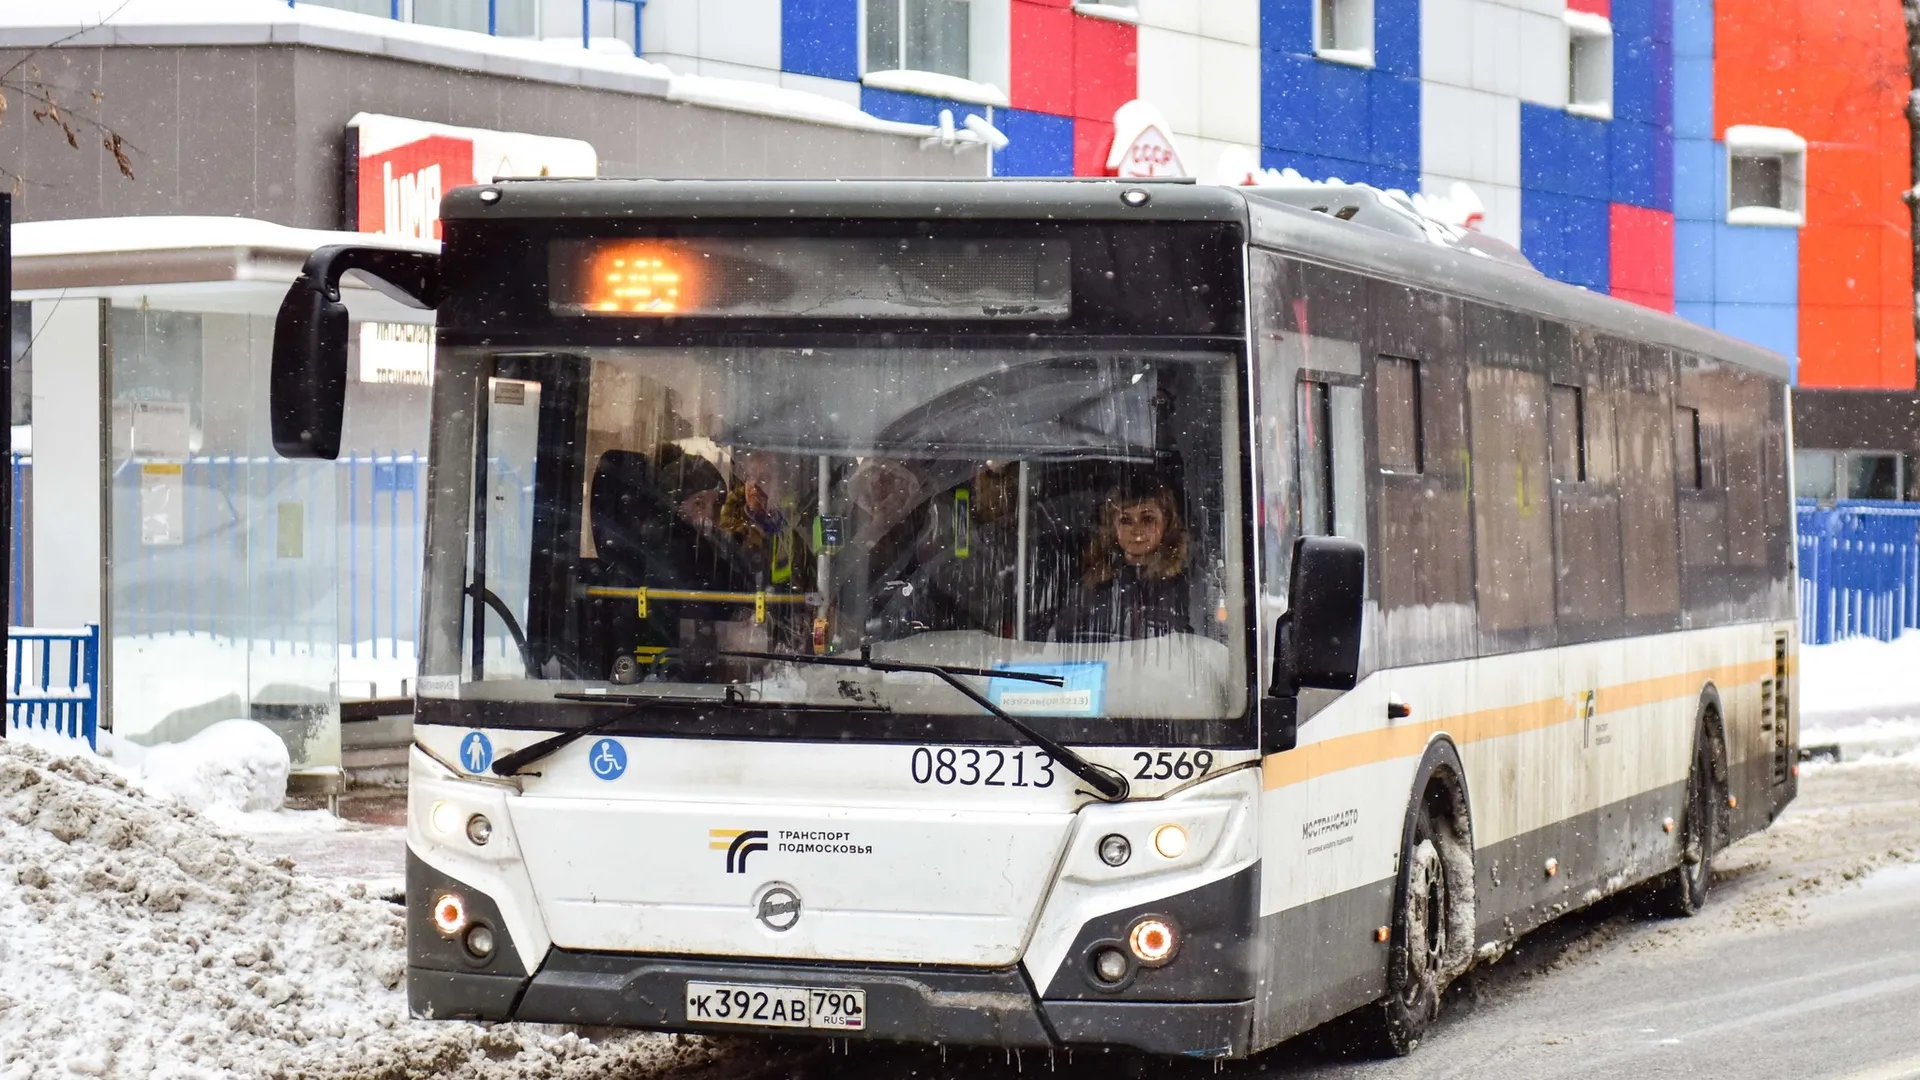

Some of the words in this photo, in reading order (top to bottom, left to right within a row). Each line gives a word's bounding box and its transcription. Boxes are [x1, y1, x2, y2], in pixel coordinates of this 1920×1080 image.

[1132, 143, 1173, 165] СССР
[911, 747, 1055, 788] 083213
[1133, 750, 1214, 781] 2569
[778, 830, 851, 841] ТРАНСПОРТ
[778, 843, 874, 854] ПОДМОСКОВЬЯ
[697, 989, 806, 1022] К392АВ
[813, 992, 857, 1016] 790
[823, 1016, 845, 1025] RUS
